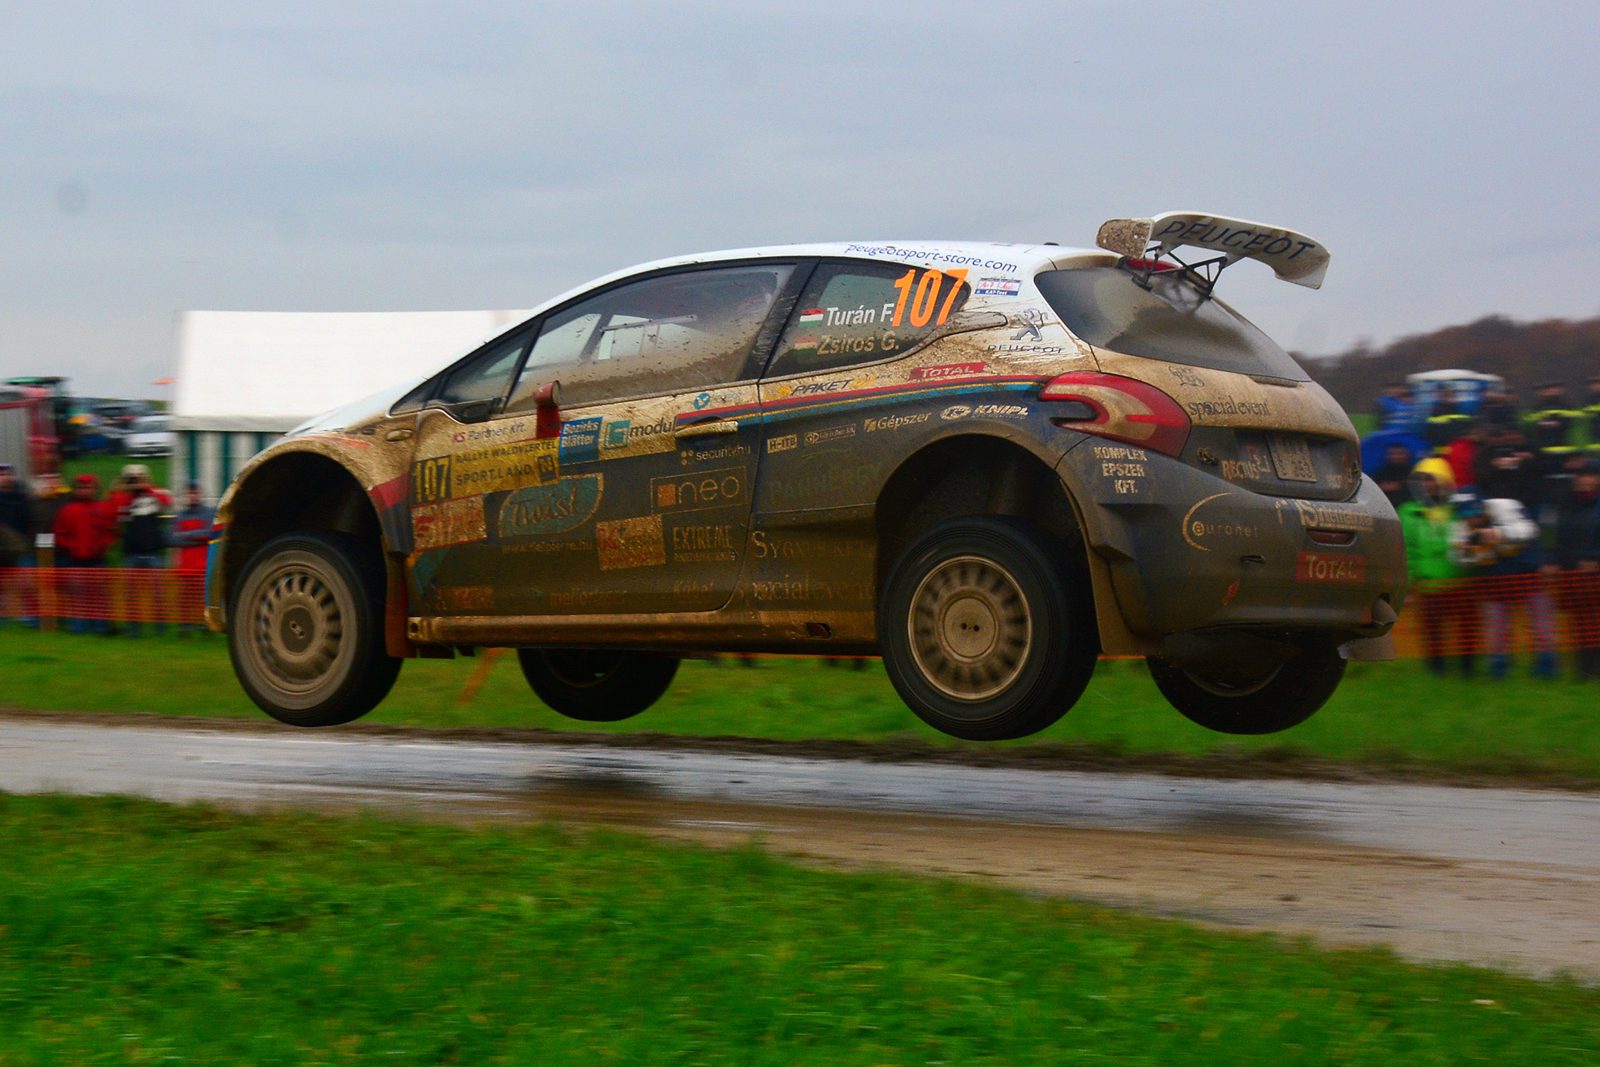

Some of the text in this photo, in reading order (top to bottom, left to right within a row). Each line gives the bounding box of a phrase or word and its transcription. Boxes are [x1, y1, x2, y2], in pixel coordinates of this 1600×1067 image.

[1157, 220, 1315, 260] PEUGEOT
[844, 243, 1018, 273] peugeotsport-store.com
[892, 268, 969, 328] 107
[826, 303, 876, 327] Turán
[920, 367, 976, 379] TOTAL
[790, 378, 854, 397] PAKET
[876, 410, 933, 432] Gépszer
[1093, 446, 1148, 462] KOMPLEX
[415, 456, 450, 503] 107
[678, 475, 740, 504] neo
[1306, 555, 1357, 580] TOTAL
